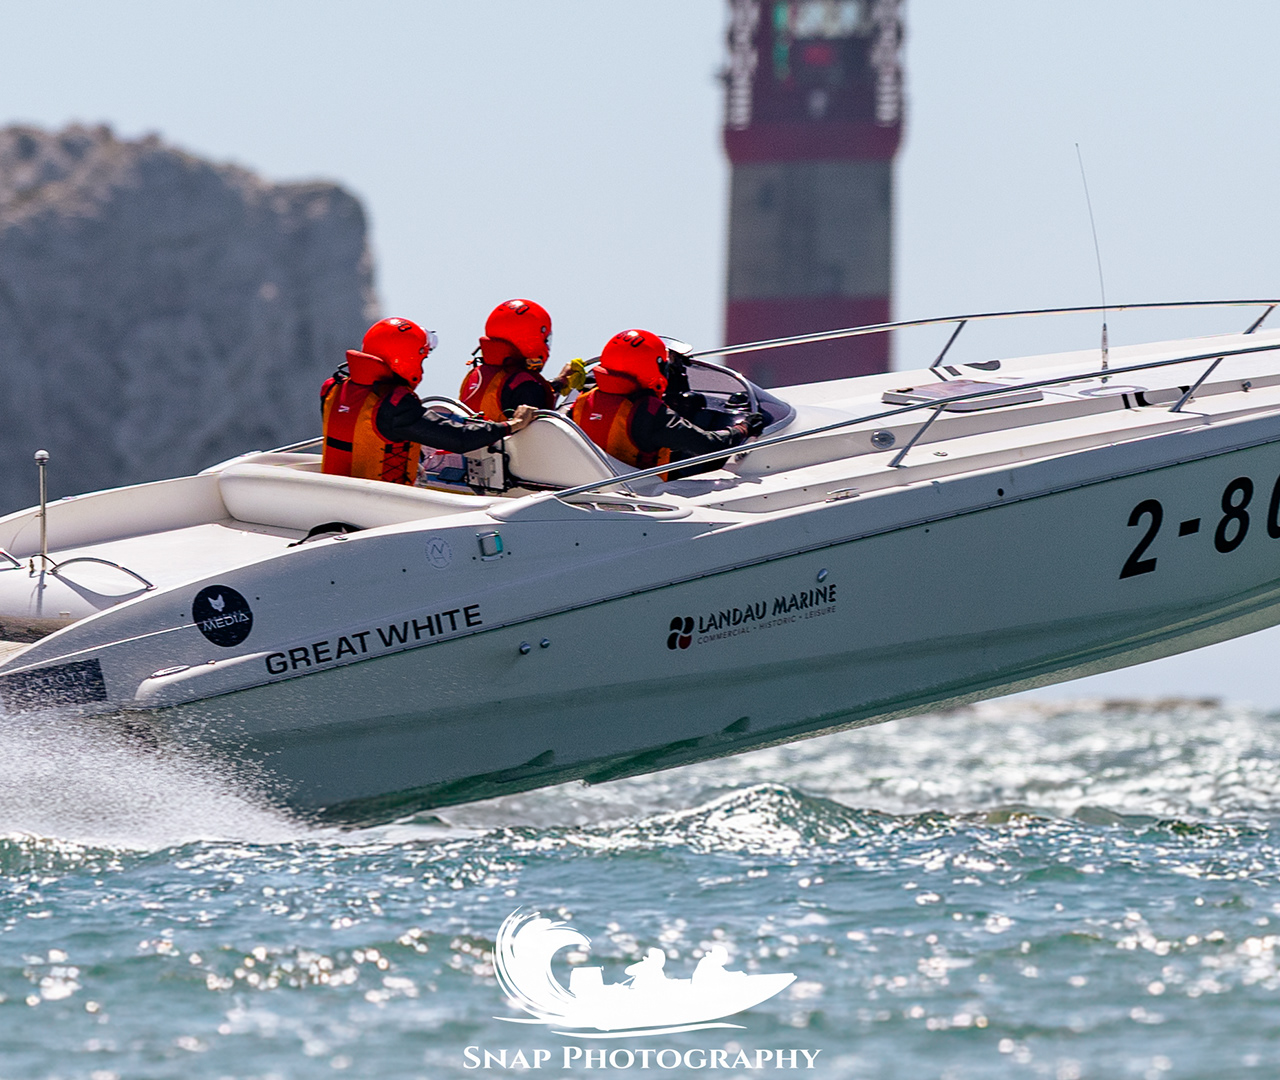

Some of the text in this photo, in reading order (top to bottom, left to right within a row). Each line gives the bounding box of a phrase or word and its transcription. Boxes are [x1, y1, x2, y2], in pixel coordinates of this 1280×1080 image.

[202, 613, 250, 631] MEDIA
[697, 605, 836, 645] COMMERCIAL HISTORIC LEISURE
[698, 584, 837, 634] LANDAU MARINE
[265, 604, 483, 675] GREAT WHITE
